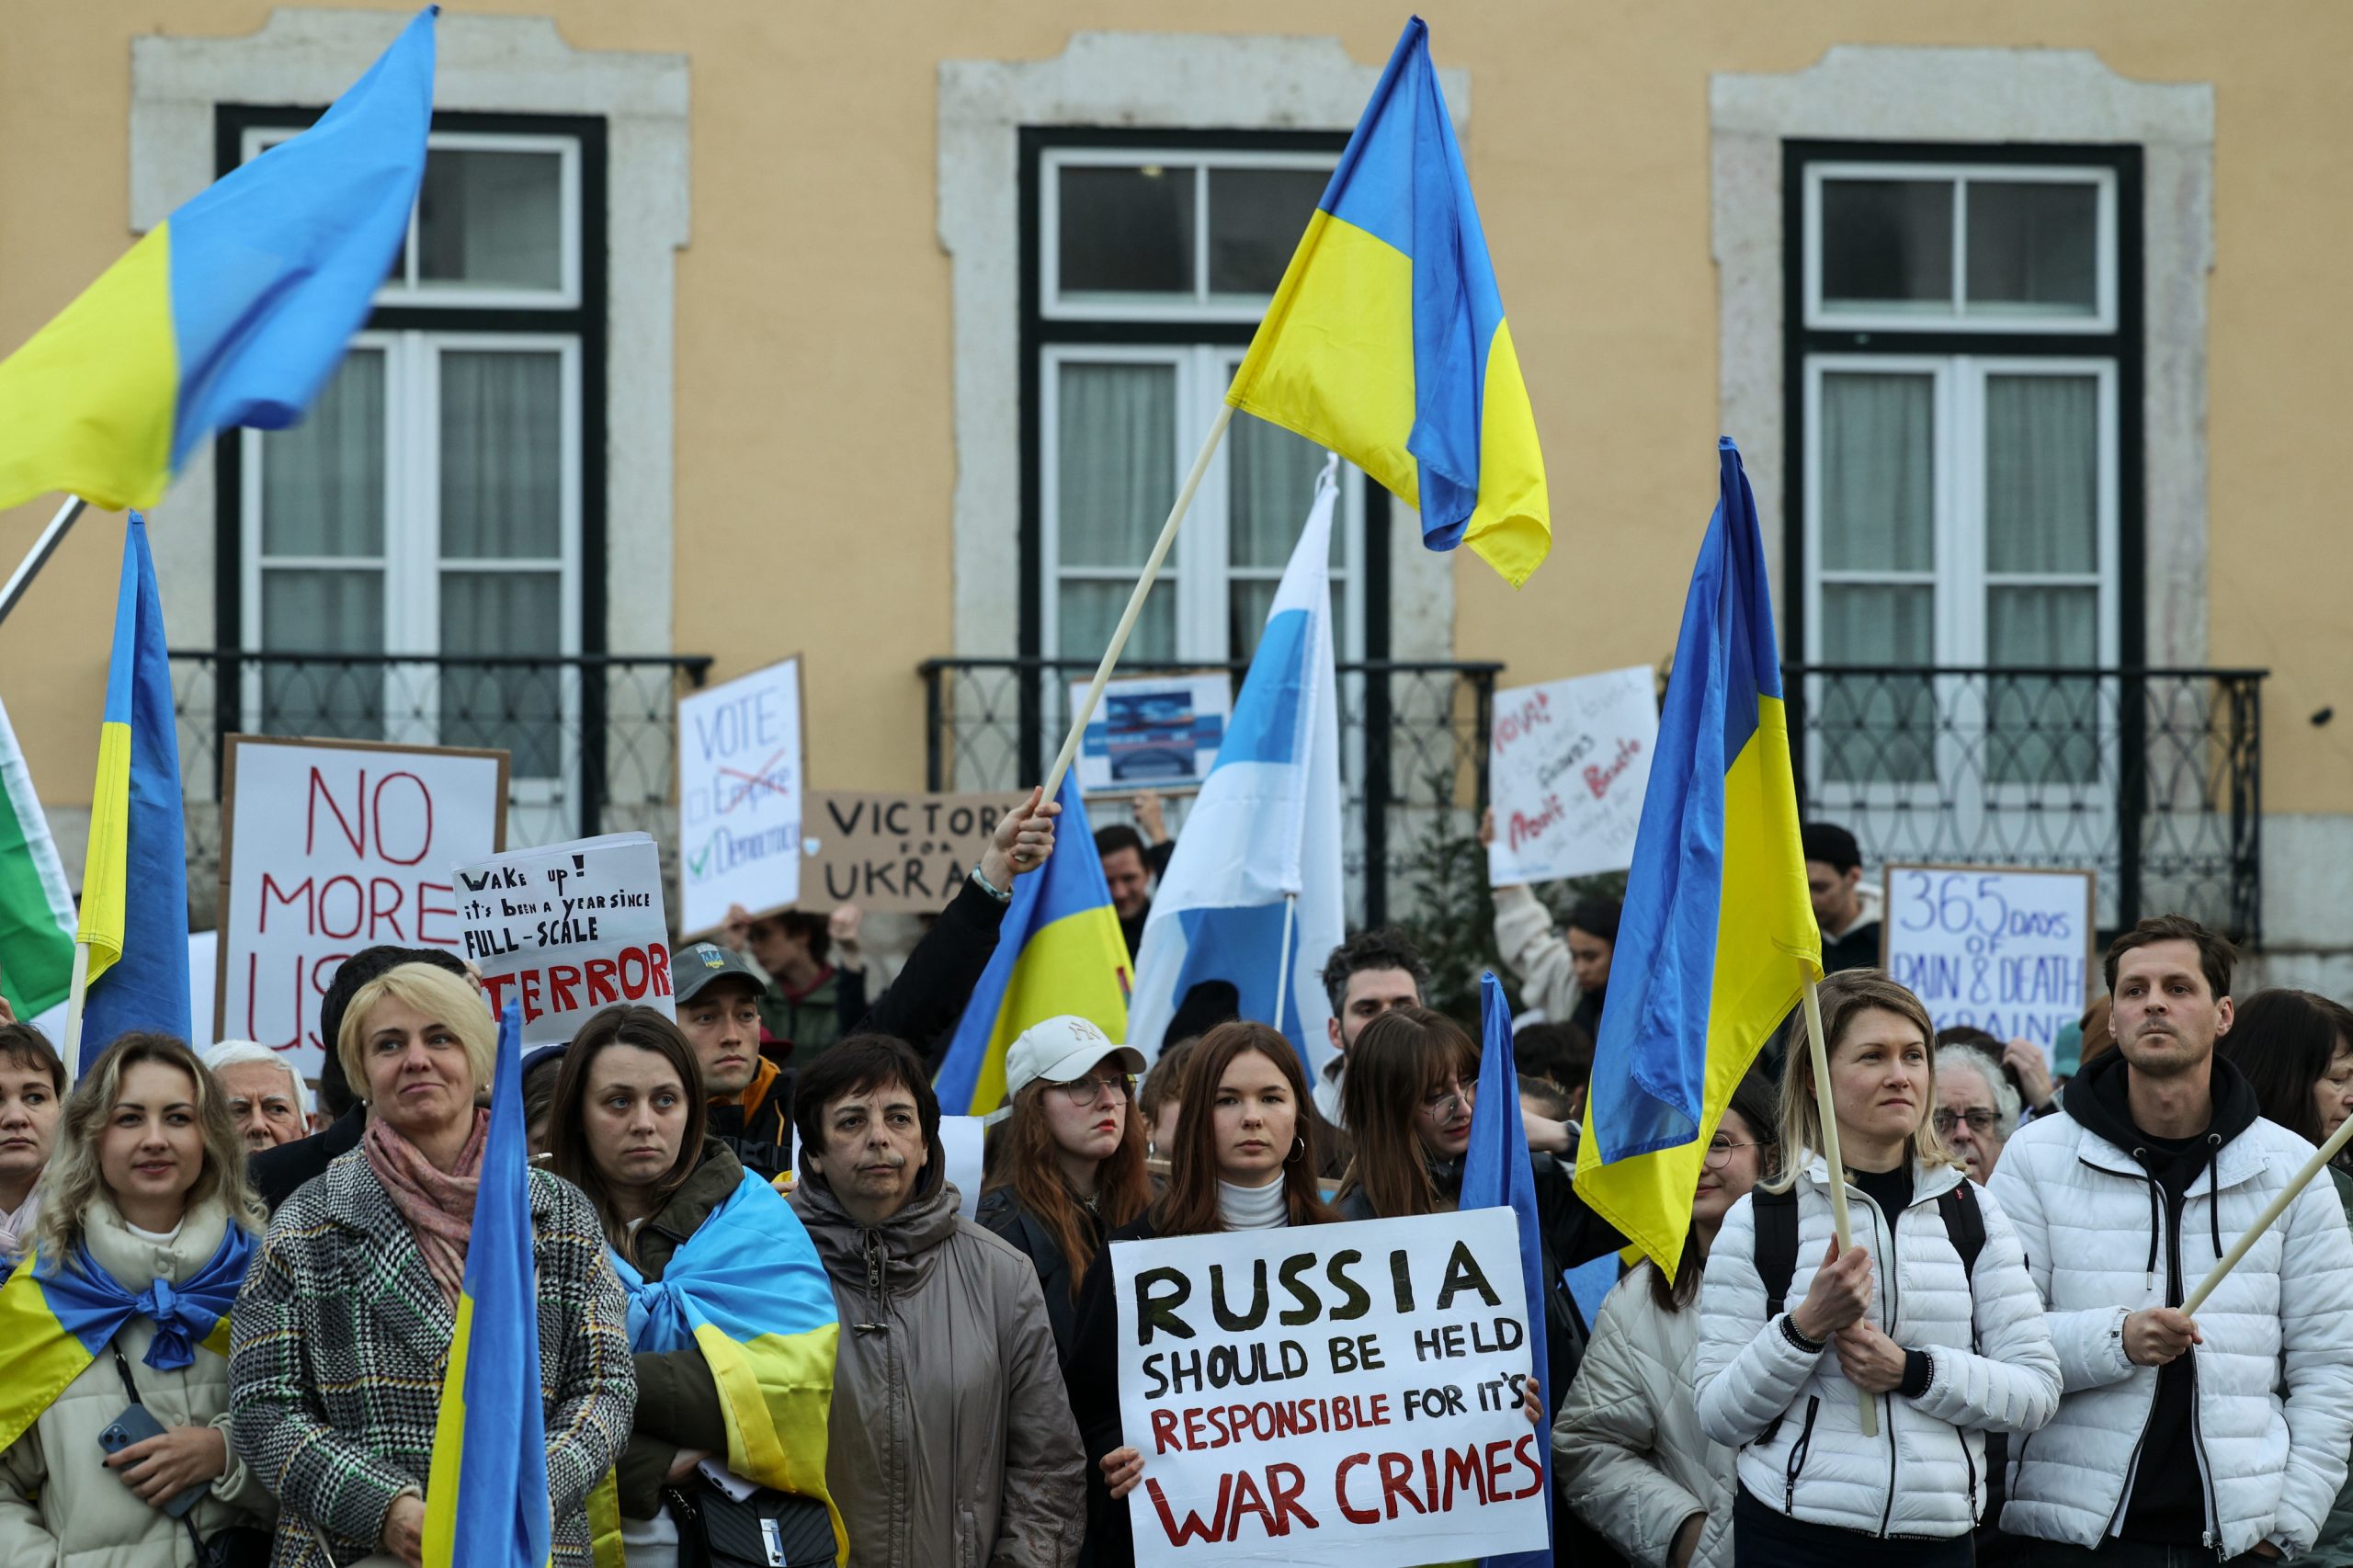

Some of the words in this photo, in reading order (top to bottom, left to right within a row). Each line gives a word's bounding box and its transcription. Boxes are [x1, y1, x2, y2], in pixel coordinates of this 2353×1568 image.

[306, 766, 432, 866] NO
[827, 801, 1011, 838] VICTOR
[258, 873, 460, 945] MORE
[825, 858, 966, 901] UKRA
[1900, 869, 2008, 937] 365
[2009, 910, 2071, 940] DAYS
[481, 943, 673, 1025] TERROR
[1893, 953, 1961, 1001] PAIN
[1999, 953, 2085, 1006] DEATH
[1965, 935, 2006, 956] OF
[1134, 1240, 1502, 1346] RUSSIA
[1142, 1339, 1308, 1400] SHOULD
[1328, 1334, 1386, 1375] BE
[1414, 1317, 1524, 1362] HELD
[1151, 1393, 1391, 1455] RESPONSIBLE
[1404, 1384, 1468, 1421] FOR
[1477, 1372, 1527, 1412] IT'S
[1145, 1462, 1319, 1548] WAR
[1335, 1434, 1544, 1525] CRIMES
